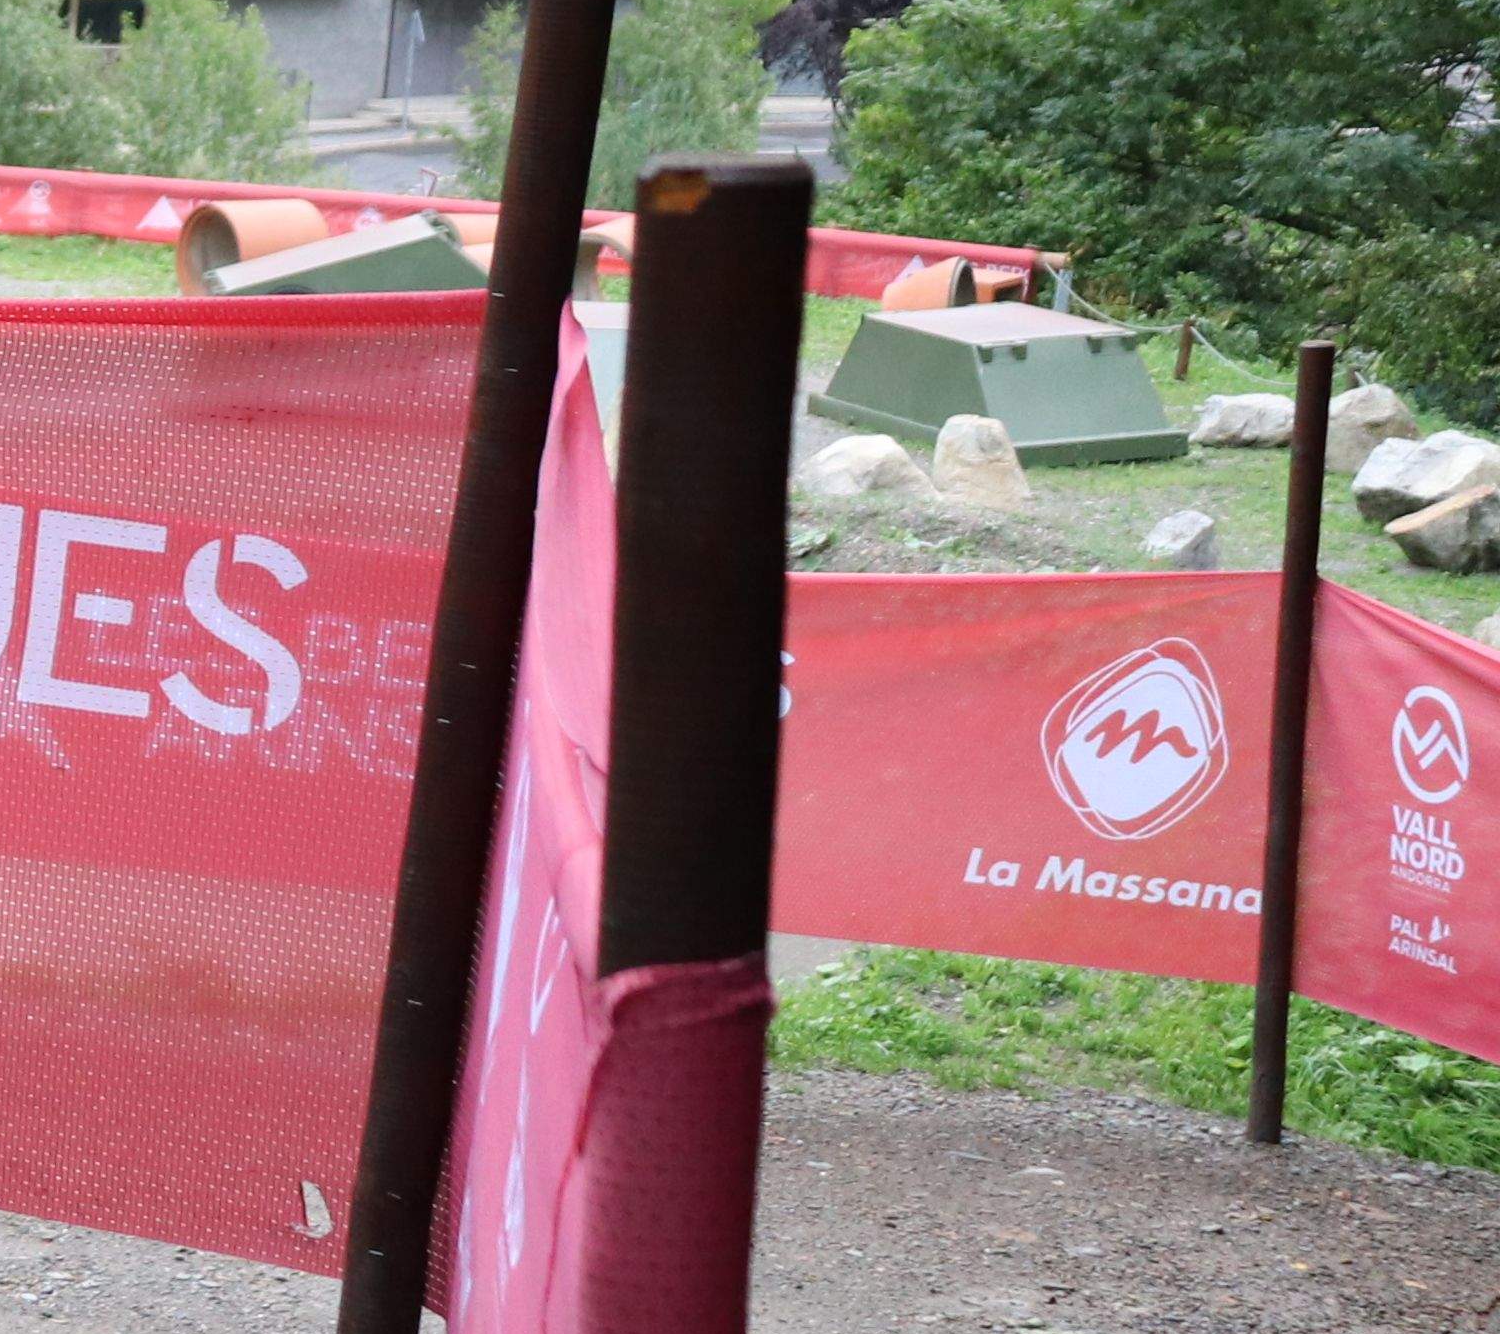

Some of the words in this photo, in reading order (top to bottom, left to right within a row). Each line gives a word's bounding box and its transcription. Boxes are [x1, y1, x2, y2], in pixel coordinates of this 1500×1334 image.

[1392, 804, 1458, 850] VALL
[1389, 833, 1466, 881] NORD
[963, 846, 1022, 888] La
[1034, 855, 1264, 915] Massana
[1389, 864, 1451, 894] ANDORRA
[1389, 913, 1424, 942] PAL
[1388, 935, 1458, 975] ARINSAL
